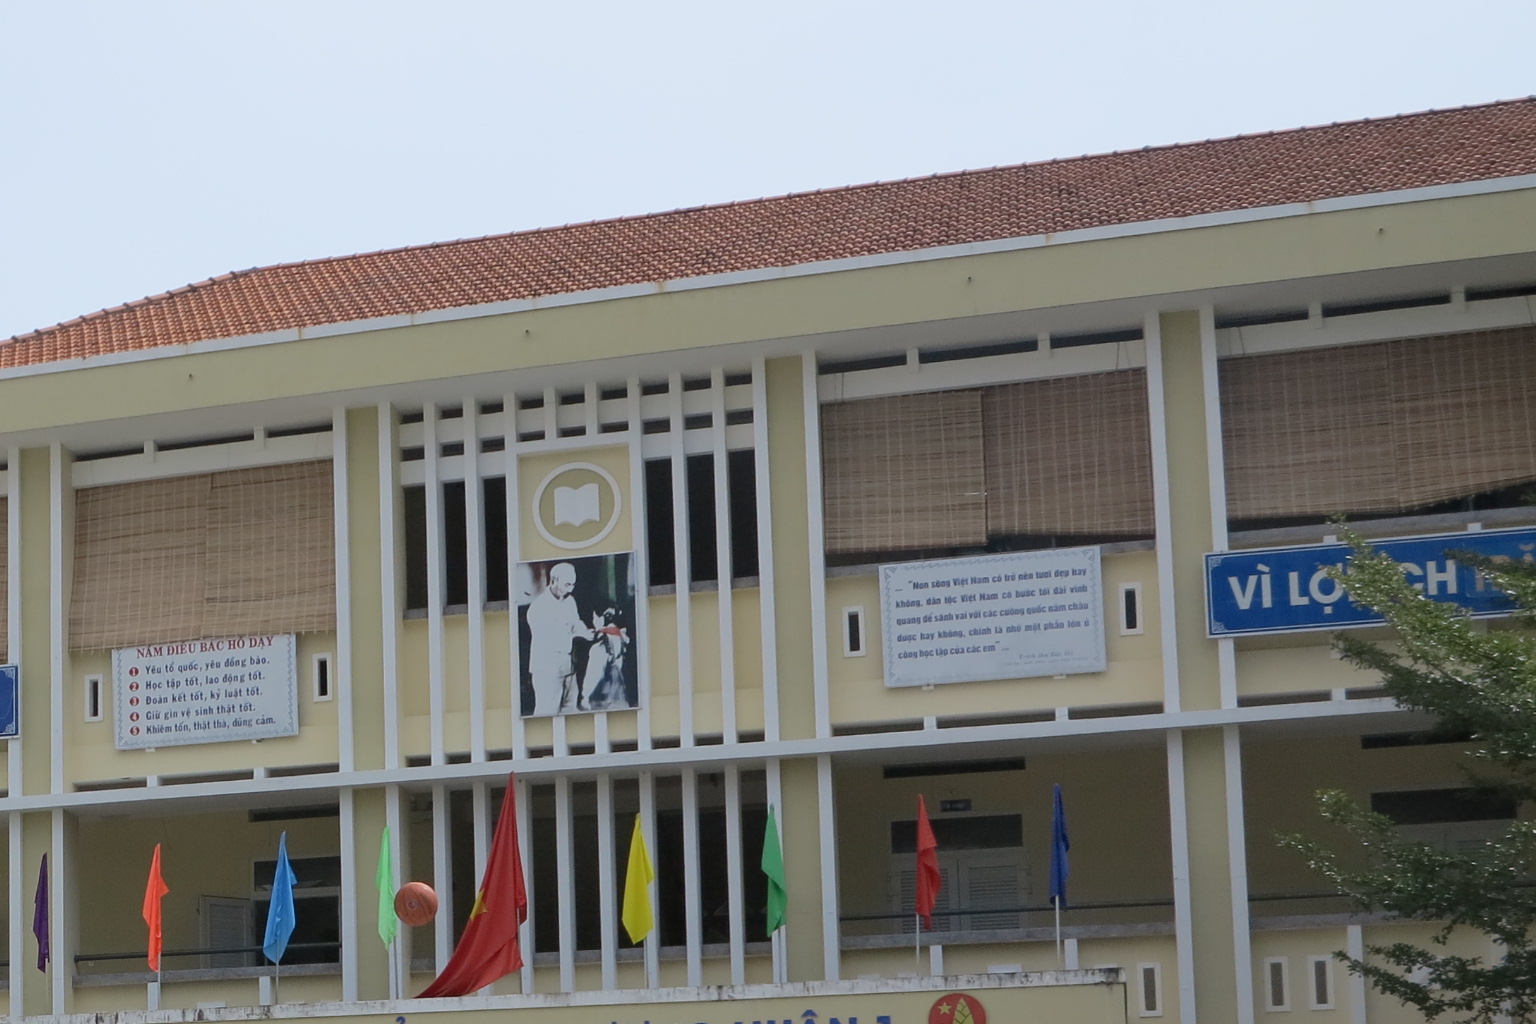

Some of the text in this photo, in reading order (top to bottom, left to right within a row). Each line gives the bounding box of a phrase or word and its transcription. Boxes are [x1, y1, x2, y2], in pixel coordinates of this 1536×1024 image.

[952, 577, 968, 587] Việt
[970, 576, 989, 584] Nam
[992, 574, 1002, 583] có
[1072, 568, 1087, 576] hay
[1228, 563, 1273, 610] VÌ
[960, 594, 976, 604] Việt
[1002, 591, 1012, 599] có
[1069, 585, 1088, 593] vinh
[896, 616, 921, 626] quang
[955, 611, 967, 620] vai
[1026, 604, 1047, 615] quốc
[995, 626, 1003, 634] là
[1025, 623, 1041, 633] một
[136, 636, 274, 659] NĂM ĐIỀU BÁC HỒ DẠY
[919, 649, 934, 660] học
[130, 667, 139, 677] 1
[145, 665, 162, 675] Yêu
[177, 660, 202, 674] quốc,
[204, 660, 221, 671] yêu
[224, 657, 247, 668] đồng
[249, 655, 270, 665] bào.
[130, 670, 265, 692] 2 Học tập tốt, lao động tốt.
[130, 685, 263, 706] 3 Đoàn kết tốt, kỷ luật tốt.
[130, 701, 256, 722] 4 Giữ gìn vệ sinh thật tốt.
[130, 714, 276, 736] 5 Khiêm tốn, thật thà, dũng cảm.
